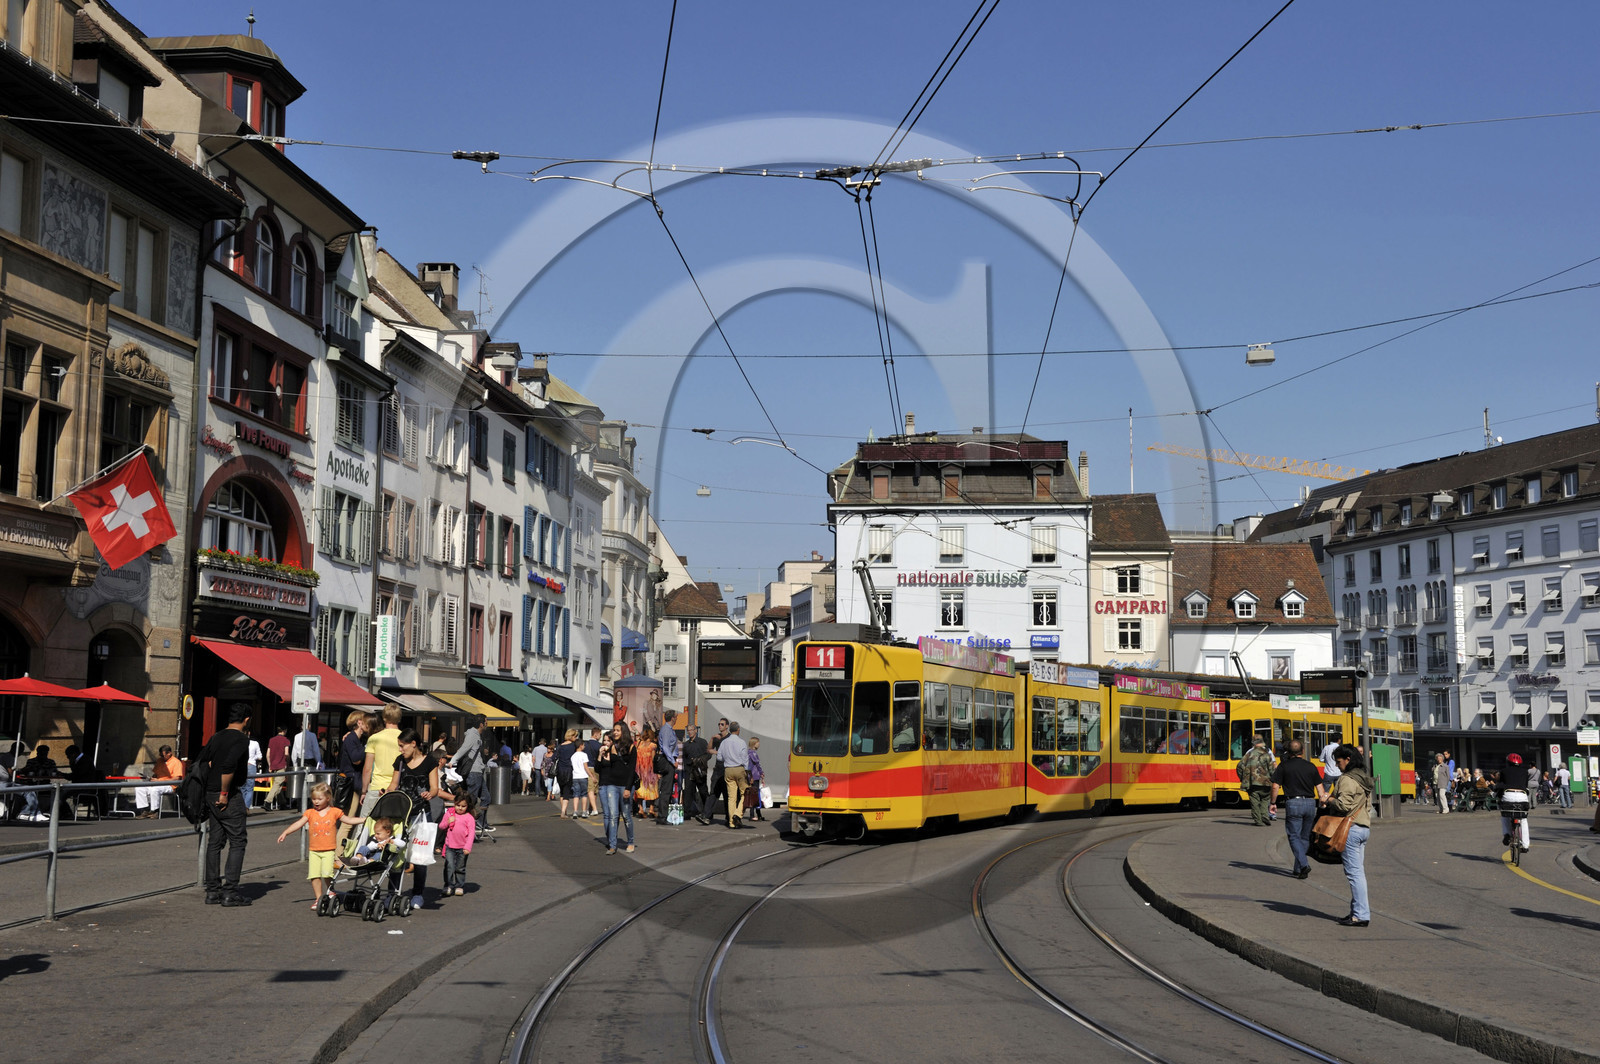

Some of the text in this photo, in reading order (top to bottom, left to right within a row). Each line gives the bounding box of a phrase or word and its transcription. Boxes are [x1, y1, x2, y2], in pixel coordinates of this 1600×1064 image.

[258, 429, 292, 459] Fourny
[326, 451, 370, 487] Apotheke
[16, 519, 48, 532] BIERHALLE
[897, 570, 1028, 585] nationale suisse
[1095, 600, 1167, 614] CAMPARI
[229, 615, 288, 644] Rio Bar
[379, 617, 388, 661] Apotheke
[816, 648, 835, 667] 11
[875, 811, 885, 821] 207
